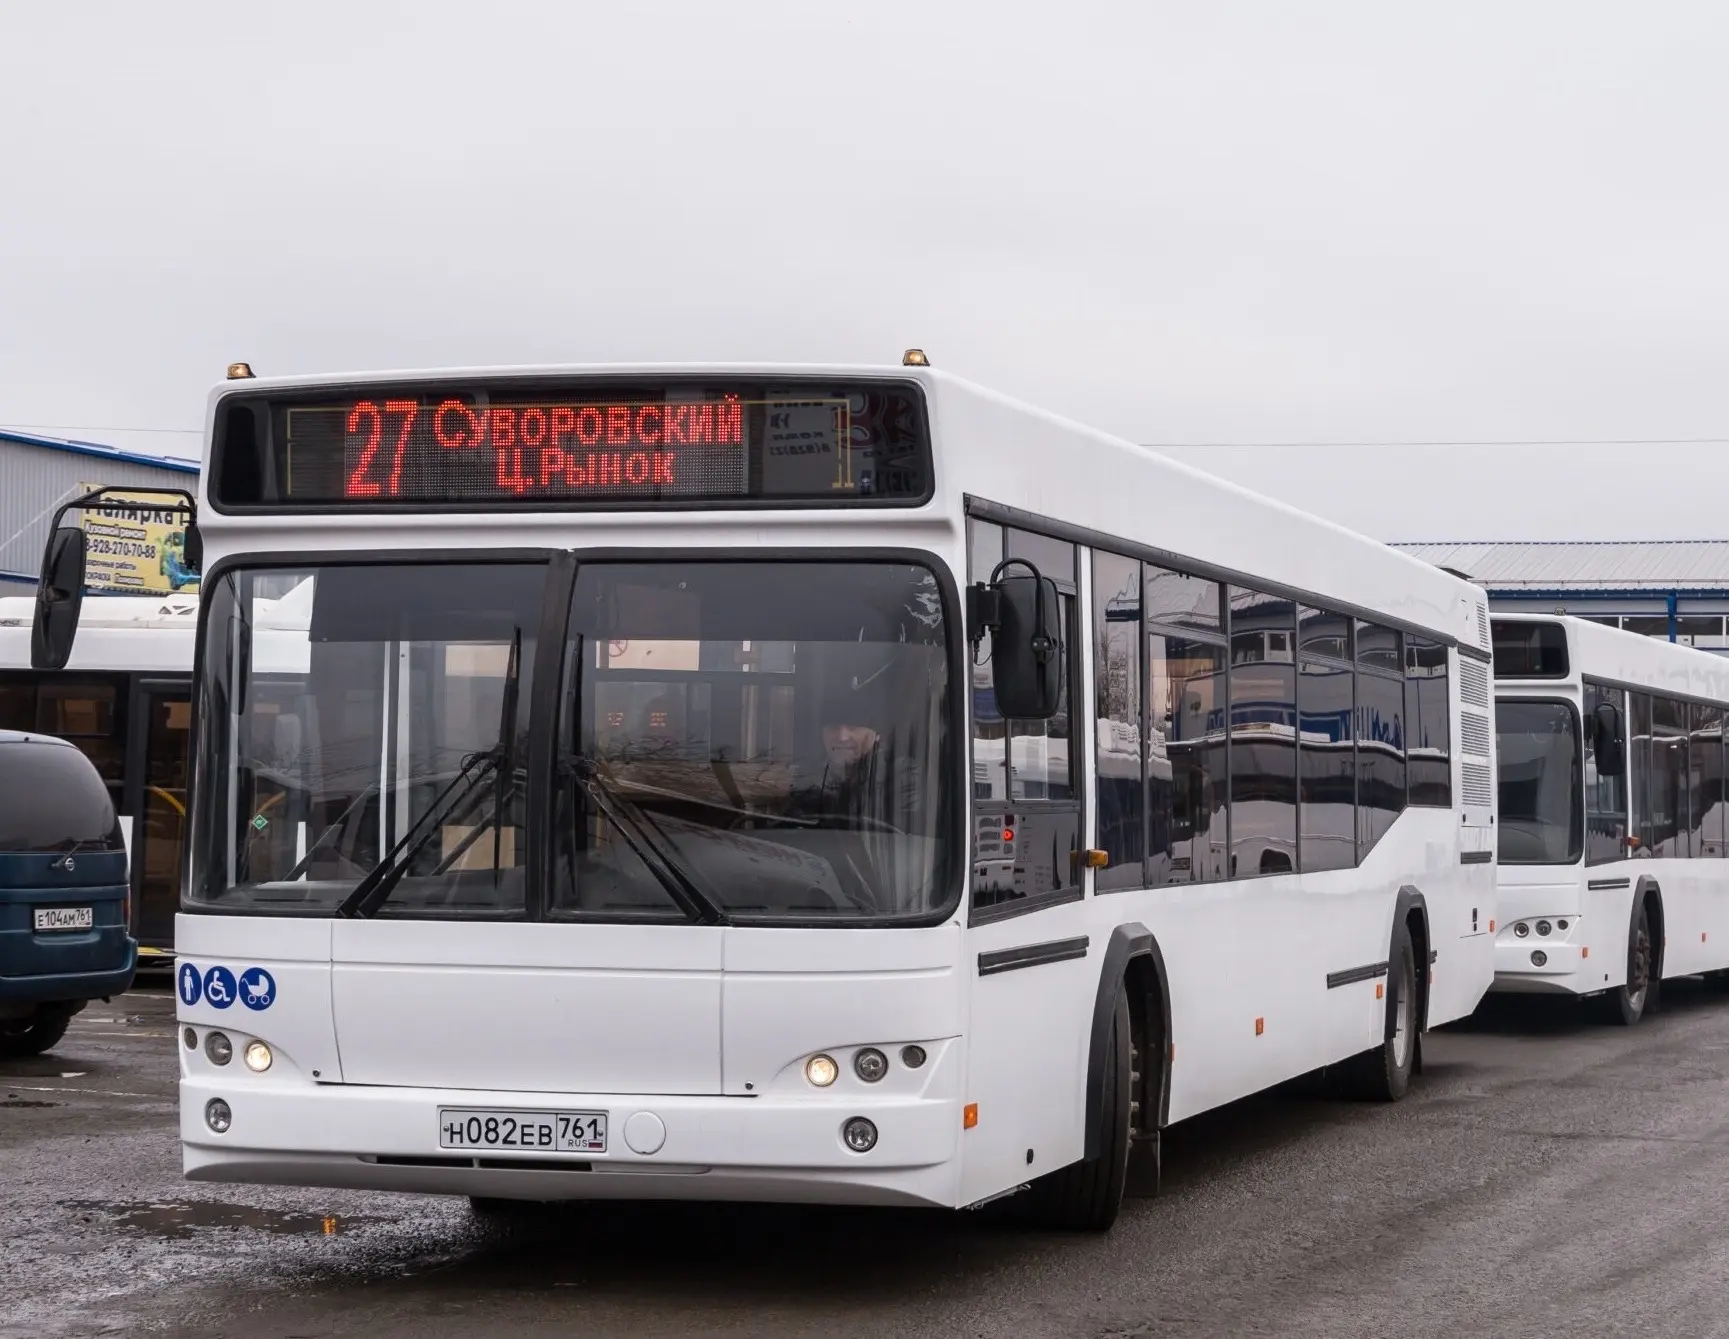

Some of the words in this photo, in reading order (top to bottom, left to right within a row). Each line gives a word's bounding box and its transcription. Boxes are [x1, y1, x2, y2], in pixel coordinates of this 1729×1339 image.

[348, 401, 418, 495] 27
[450, 1116, 552, 1146] Н082ЕВ
[558, 1117, 598, 1140] 761
[568, 1139, 588, 1148] RUS
